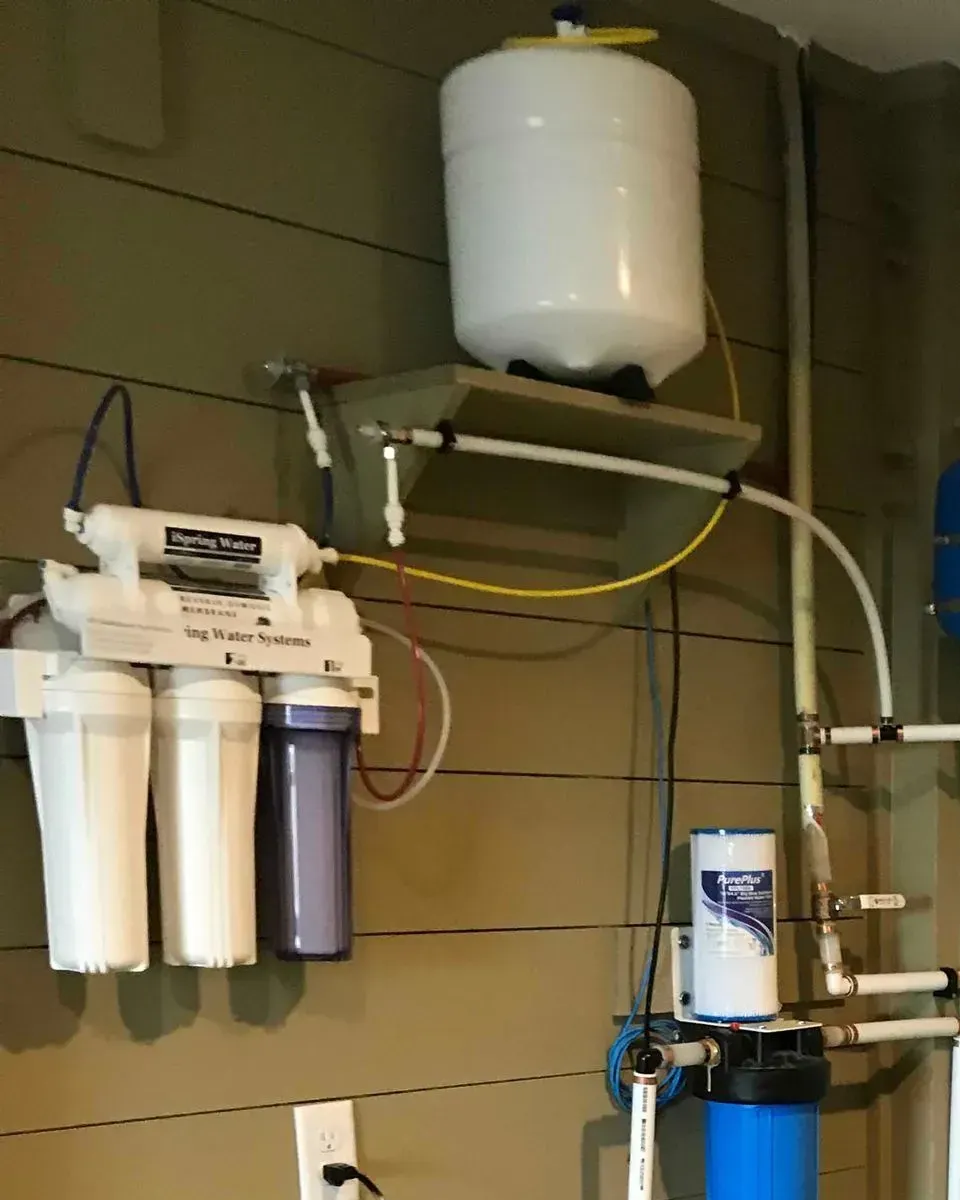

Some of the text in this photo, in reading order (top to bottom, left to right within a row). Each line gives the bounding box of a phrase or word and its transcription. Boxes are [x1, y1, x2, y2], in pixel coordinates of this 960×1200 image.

[219, 537, 257, 551] Water
[212, 627, 255, 643] Water
[258, 630, 312, 648] Systems
[717, 874, 761, 884] PurePlus
